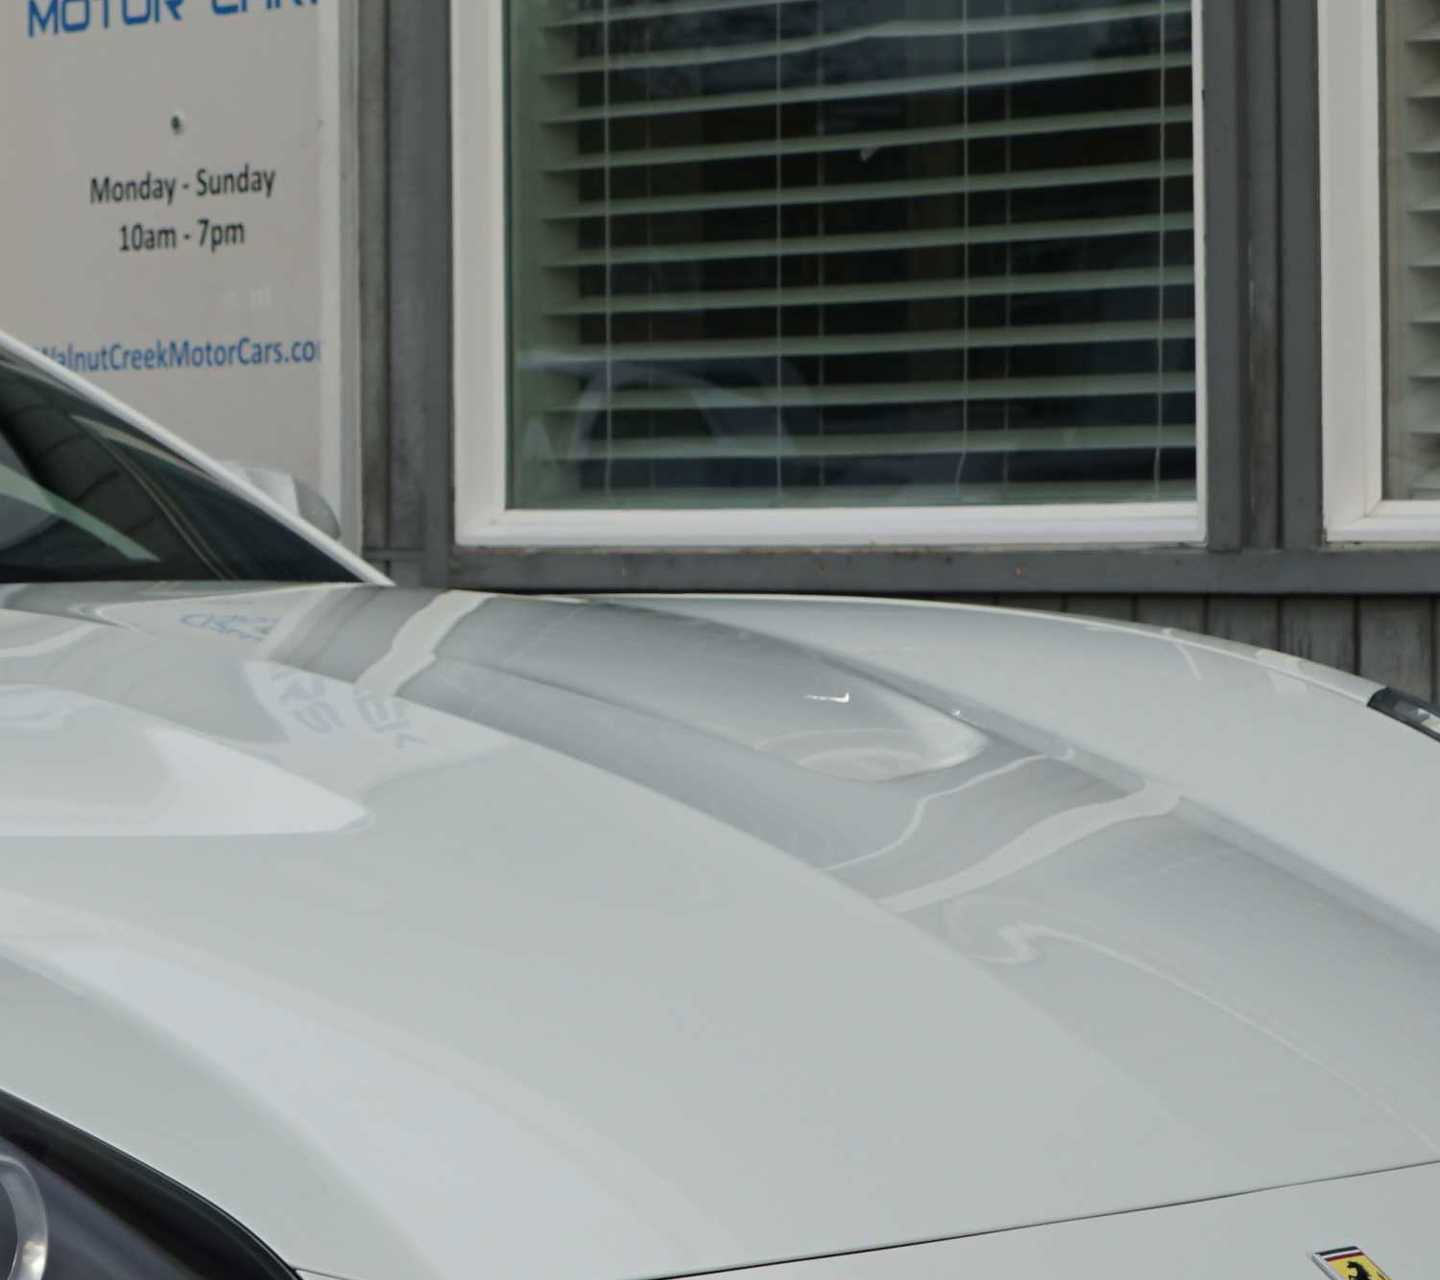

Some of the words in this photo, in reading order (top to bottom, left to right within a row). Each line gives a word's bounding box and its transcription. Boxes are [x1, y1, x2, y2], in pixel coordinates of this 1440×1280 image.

[90, 172, 175, 205] Monday
[196, 164, 276, 197] Sunday
[120, 223, 176, 252] 10am
[197, 219, 245, 252] 7pm
